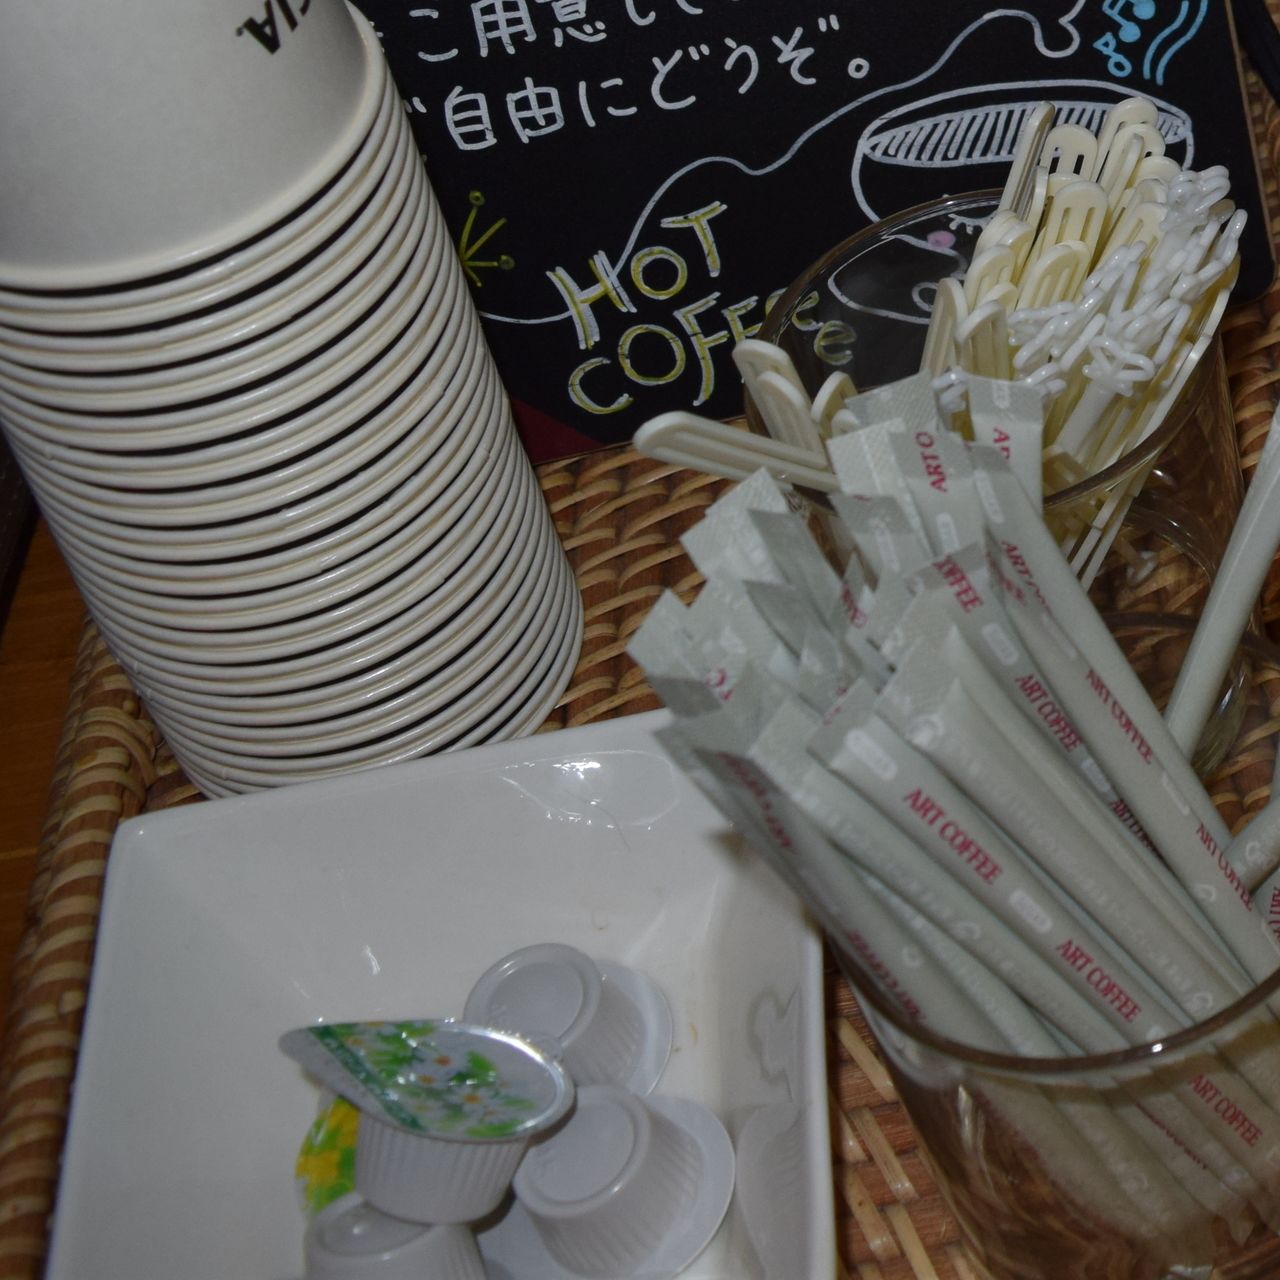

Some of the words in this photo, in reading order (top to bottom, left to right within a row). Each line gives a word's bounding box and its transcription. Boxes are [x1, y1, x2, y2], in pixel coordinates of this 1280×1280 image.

[405, 16, 870, 152] 自由にどうぞ。
[545, 201, 728, 350] HOT
[1014, 673, 1046, 705] ART
[1036, 698, 1083, 754] COFFEE
[904, 787, 945, 827] ART
[938, 821, 1004, 886] COFFEE
[1055, 938, 1095, 972] ART
[1085, 965, 1142, 1024] COFFEE
[1186, 1073, 1221, 1107] ART
[1214, 1095, 1264, 1148] COFFEE
